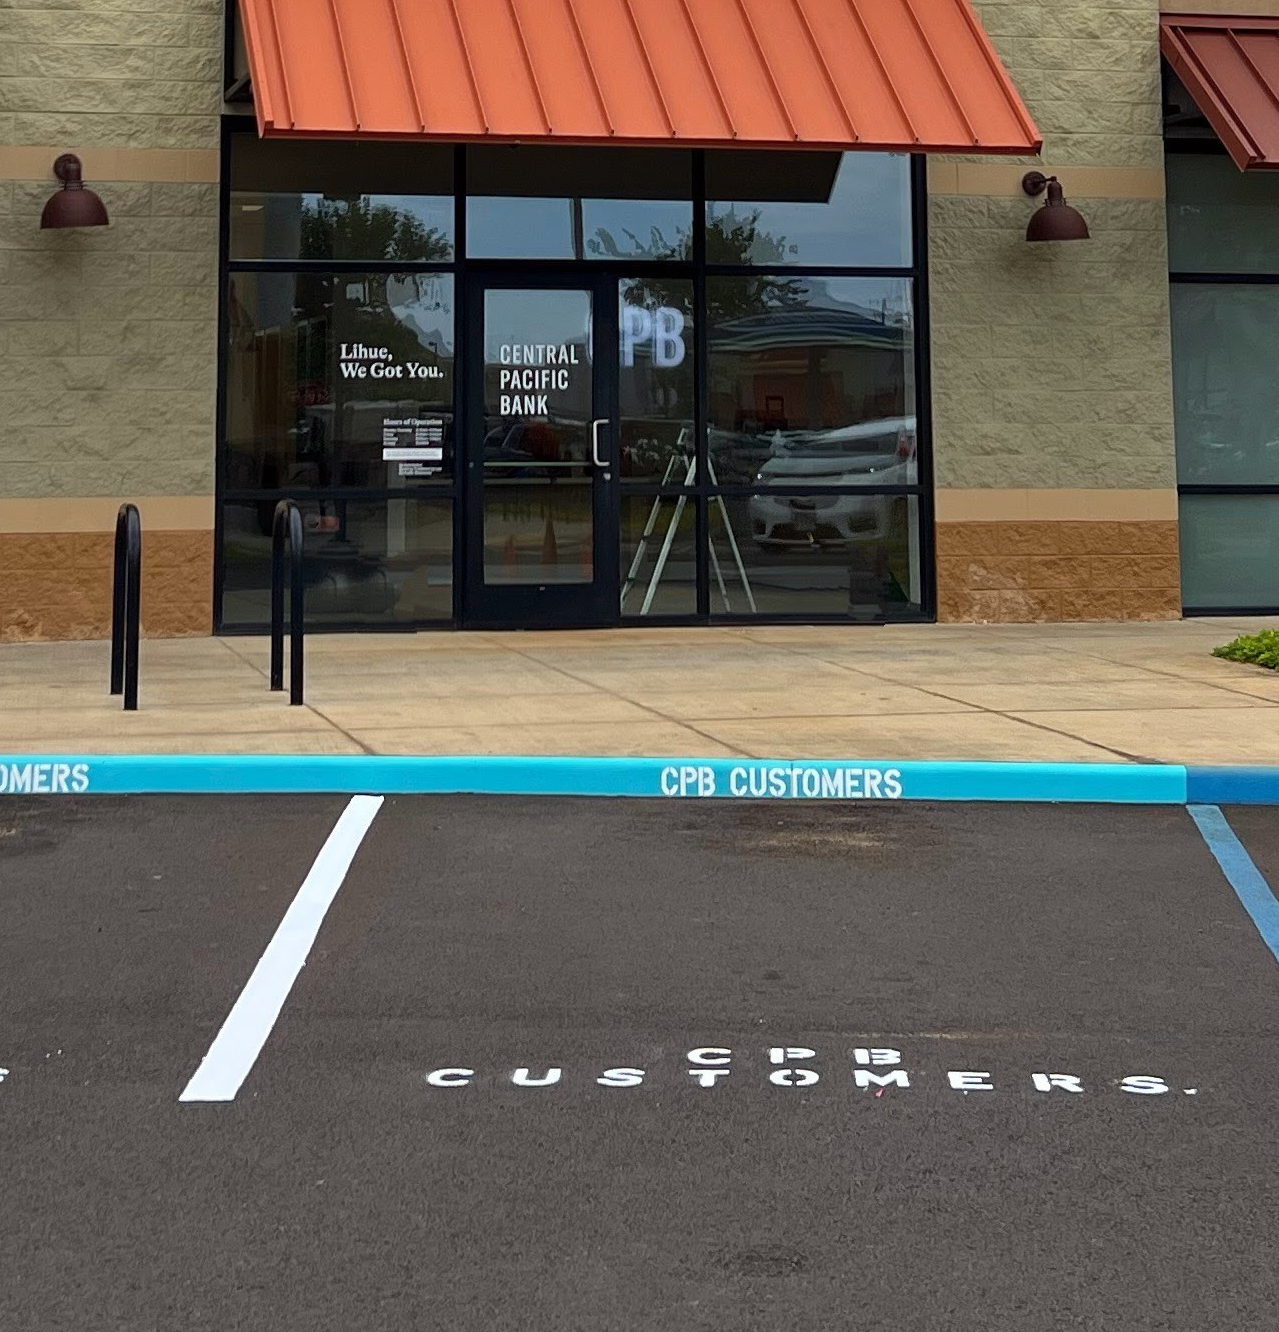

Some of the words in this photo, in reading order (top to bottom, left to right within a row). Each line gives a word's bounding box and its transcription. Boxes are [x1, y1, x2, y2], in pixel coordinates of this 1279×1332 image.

[340, 343, 394, 362] Lihue,
[500, 345, 579, 366] CENTRAL
[339, 362, 367, 379] We
[370, 362, 403, 379] Got
[406, 362, 445, 379] You.
[500, 369, 570, 391] PACIFIC
[500, 394, 549, 416] BANK
[660, 766, 716, 797] CPB
[729, 767, 903, 799] CUSTOMERS
[686, 1047, 902, 1065] CPB
[425, 1067, 1170, 1094] CUSTOMERS
